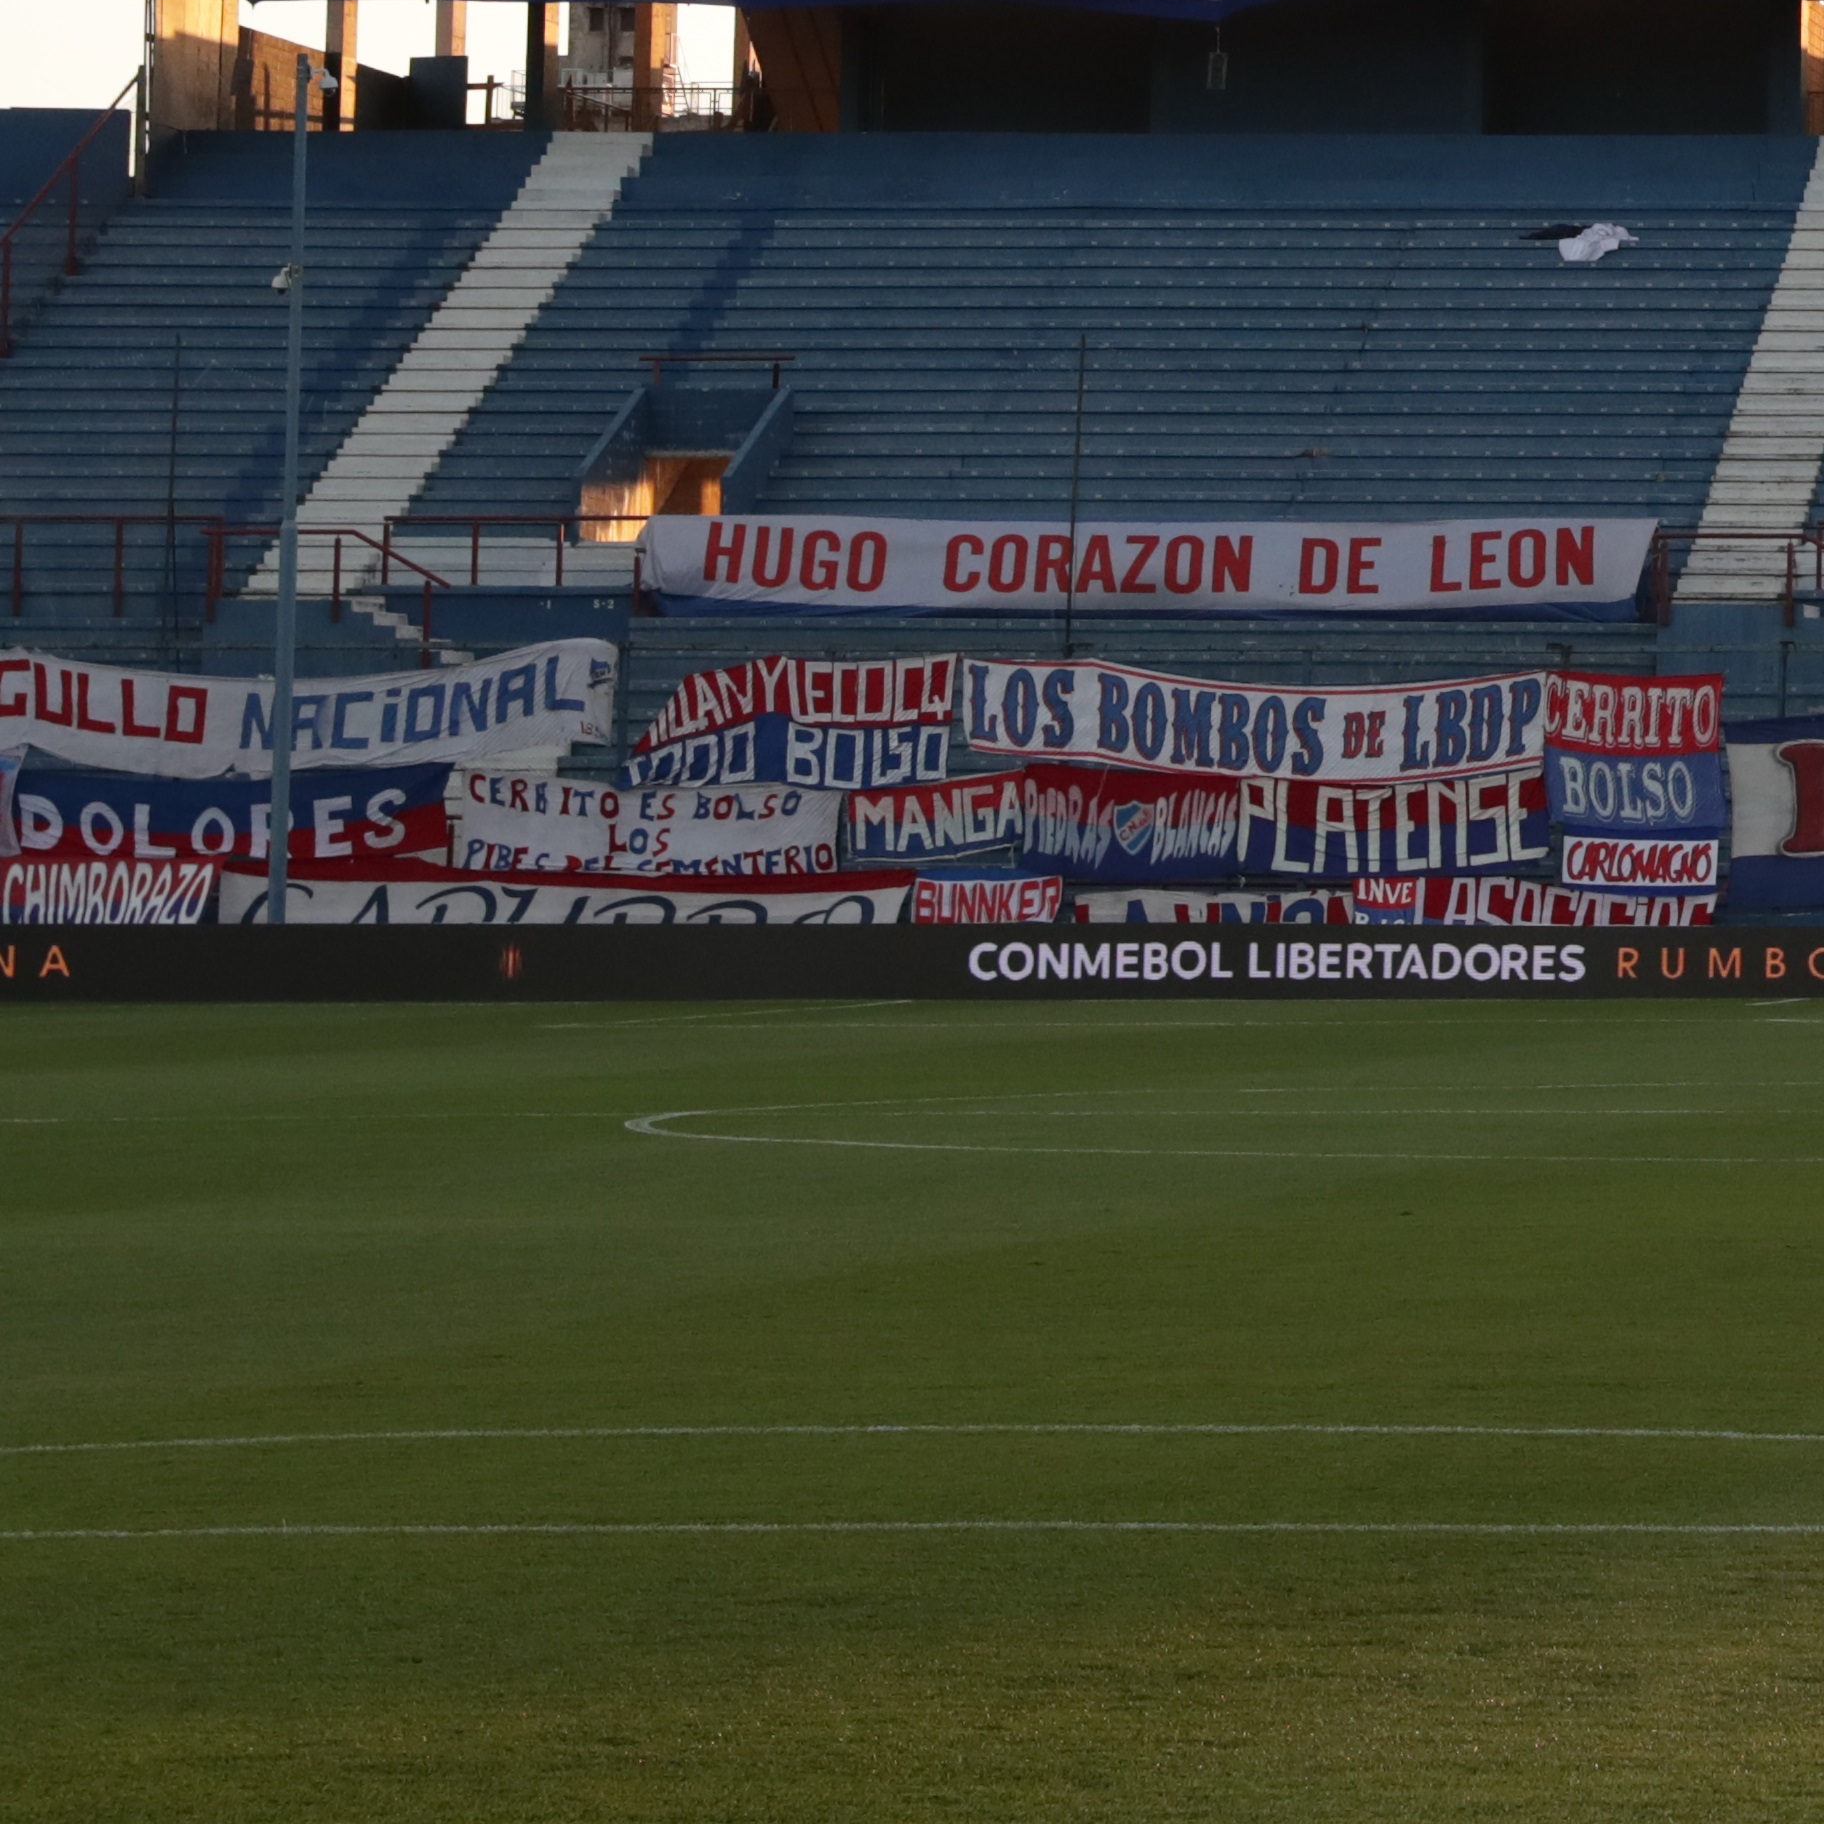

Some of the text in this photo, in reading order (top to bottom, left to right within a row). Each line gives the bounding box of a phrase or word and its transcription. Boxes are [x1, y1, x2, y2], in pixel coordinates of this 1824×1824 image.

[703, 521, 1596, 595] HUGO CORAZON DE LEON
[968, 664, 1542, 777] LOS BOMBOS DE LBDP
[1544, 674, 1719, 749] CERRITO
[786, 721, 950, 789] BOLSO
[18, 787, 407, 859] DOLORES
[639, 790, 677, 821] ES
[691, 789, 803, 821] BOLSO
[853, 780, 1024, 853] MANGA
[1237, 773, 1550, 874] PLATENSE
[1559, 756, 1695, 824] BOLSO
[608, 823, 672, 857] LOS
[1149, 787, 1238, 866] BLANCAS
[1357, 878, 1414, 904] INVE
[1566, 840, 1713, 884] CARLOMAGNO
[914, 878, 1062, 924] BUNNKER
[968, 941, 1234, 981] CONMEBOL
[1248, 942, 1587, 983] LIBERTADORES
